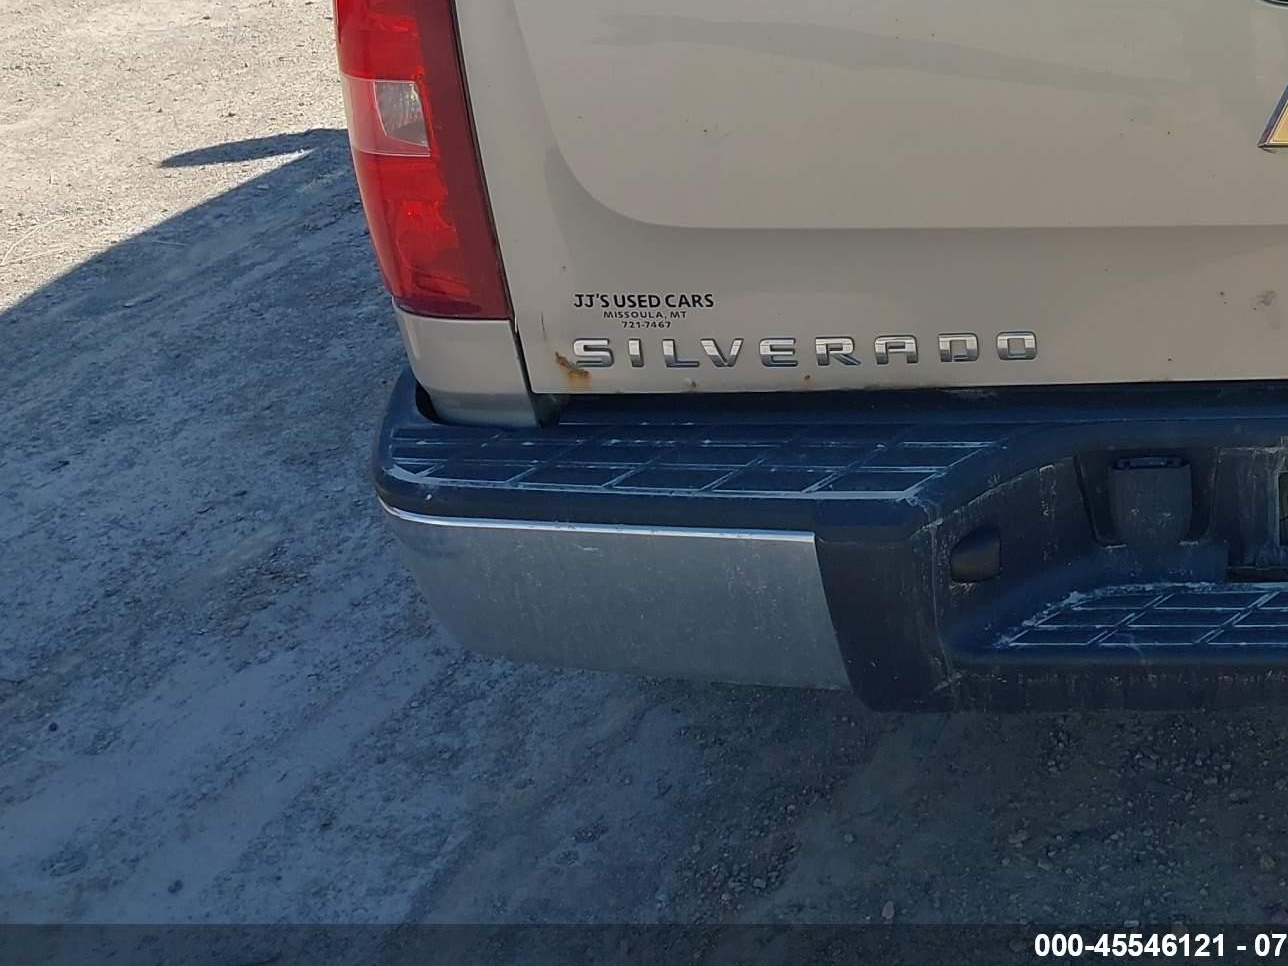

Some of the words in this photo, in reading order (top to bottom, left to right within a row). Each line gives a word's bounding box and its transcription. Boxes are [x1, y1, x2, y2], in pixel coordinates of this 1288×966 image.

[573, 293, 610, 308] JJ'S
[613, 294, 661, 308] USED
[665, 293, 715, 308] CARS
[603, 311, 668, 320] MISSOULA,
[670, 311, 687, 319] MT
[621, 321, 672, 329] 721-7467
[572, 331, 1039, 369] SILVERADO
